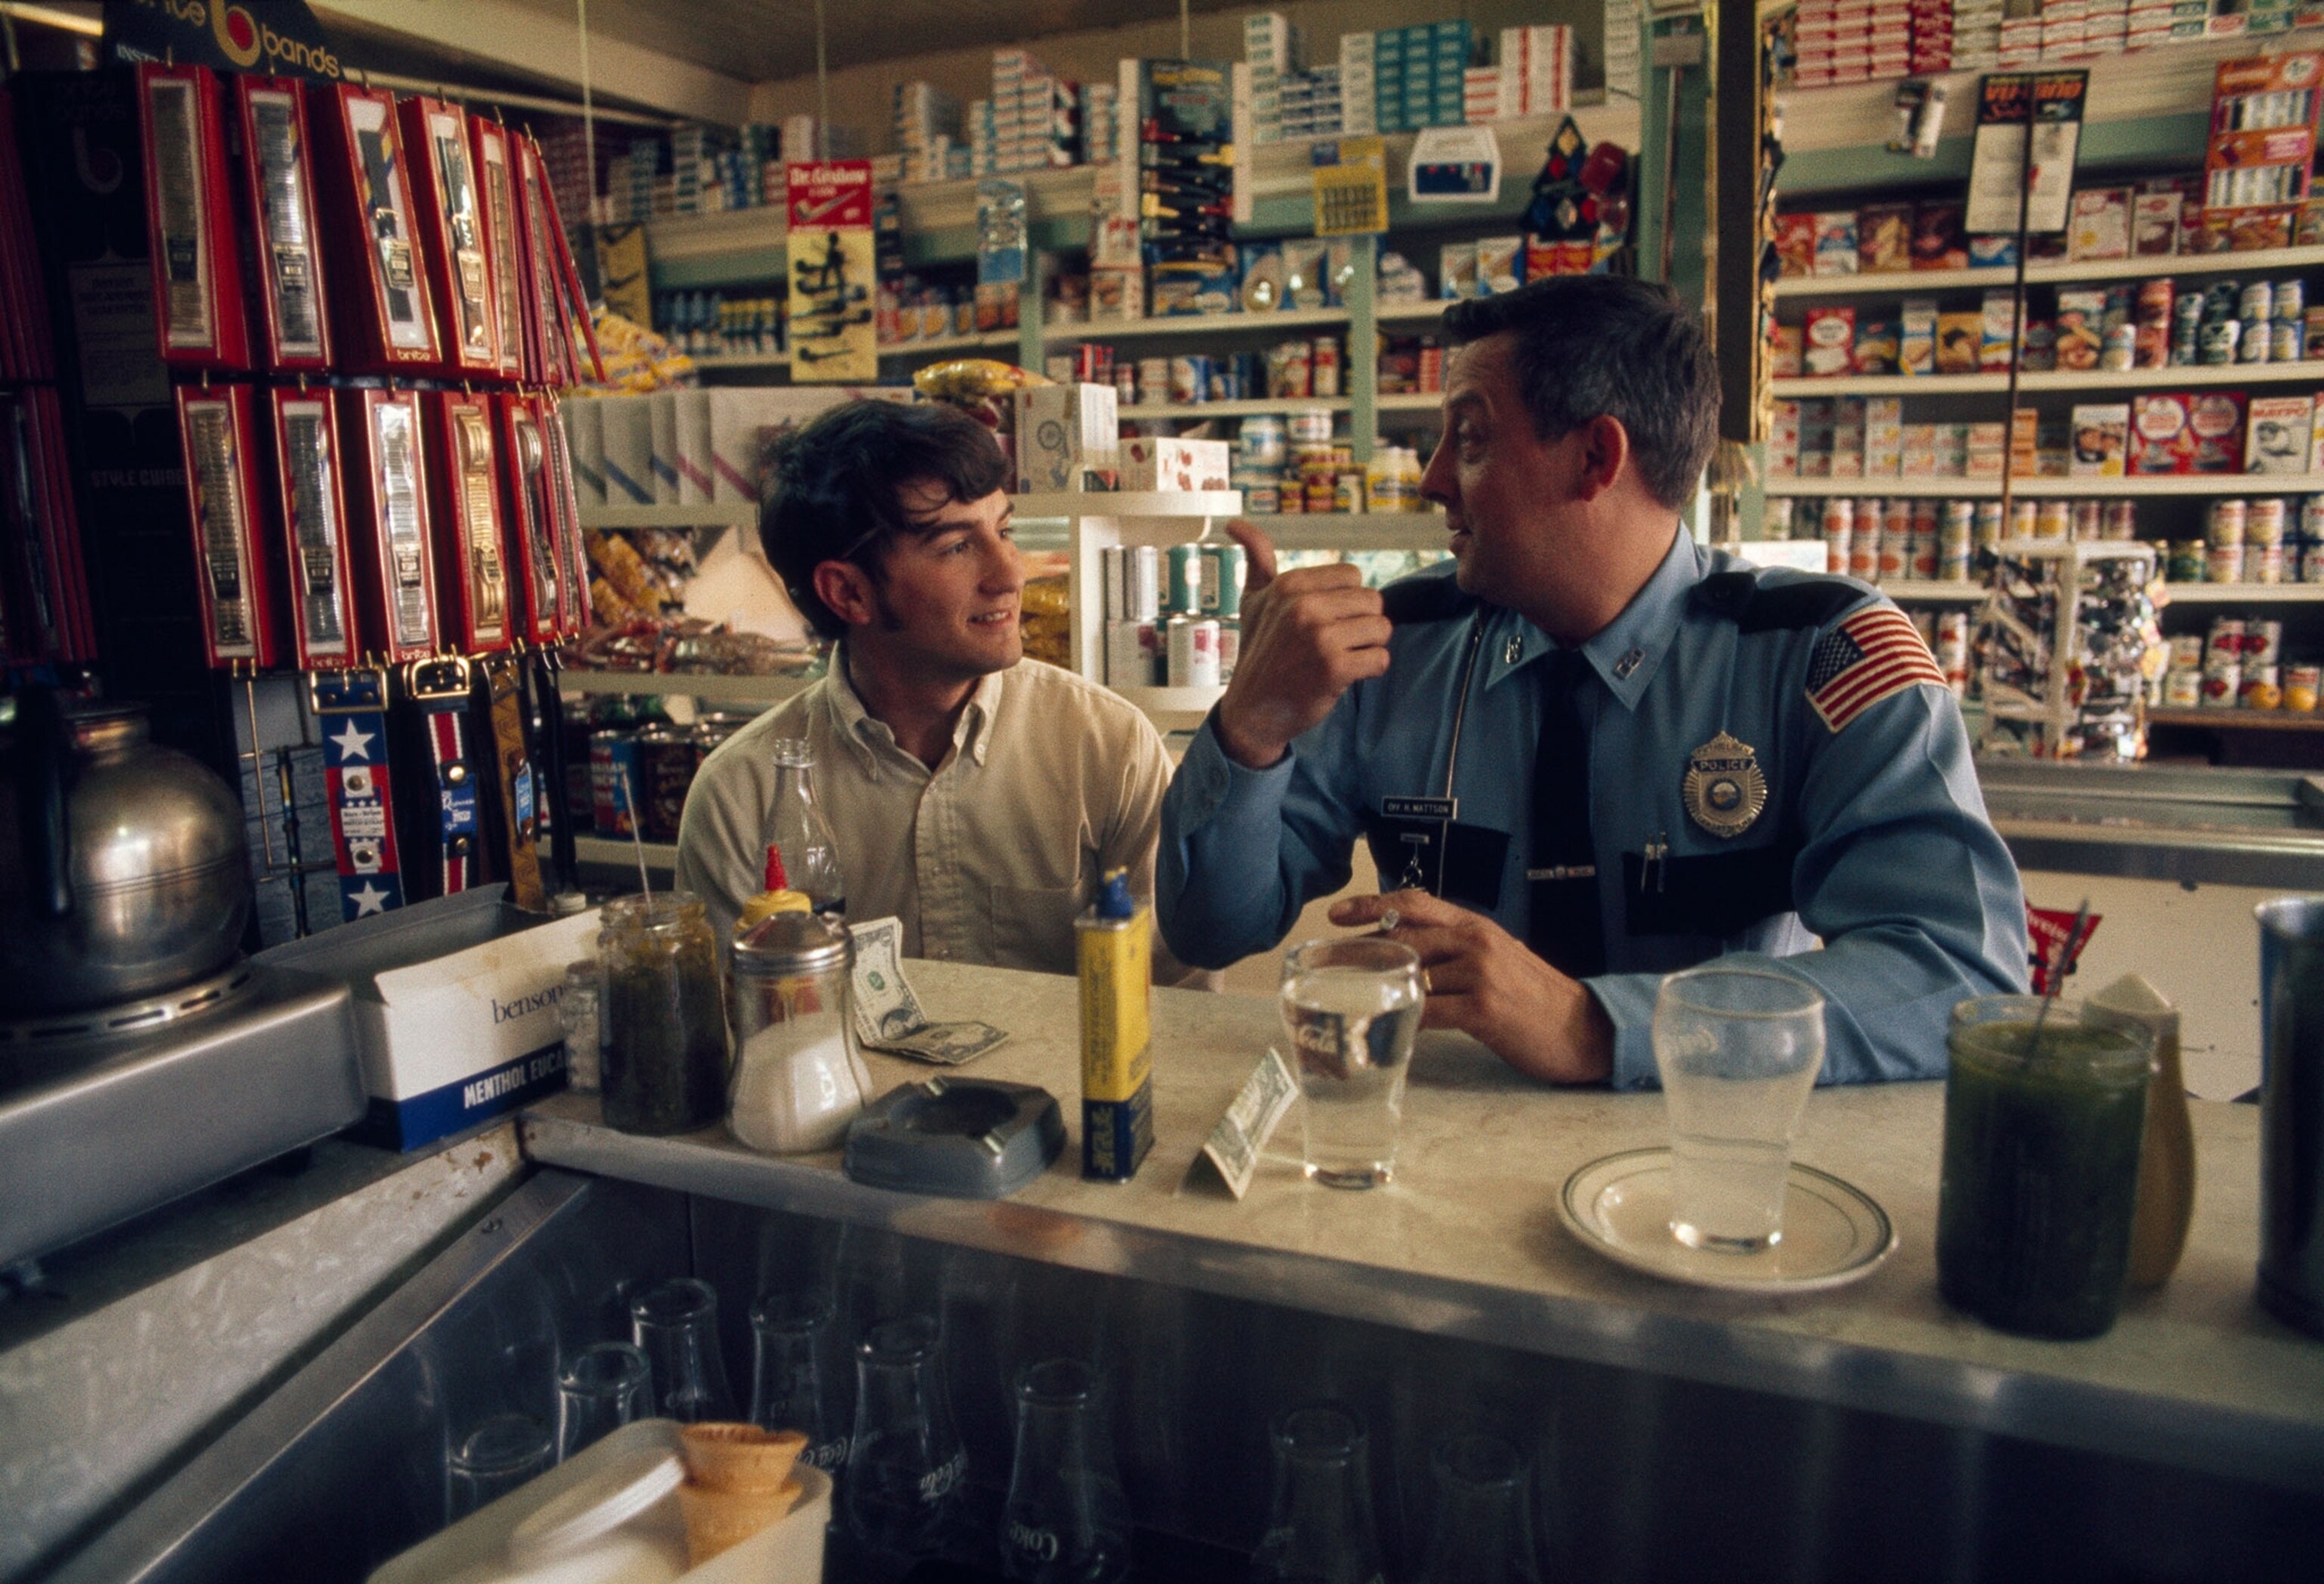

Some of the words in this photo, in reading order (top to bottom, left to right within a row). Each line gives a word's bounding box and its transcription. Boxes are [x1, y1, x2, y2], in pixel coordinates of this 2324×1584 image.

[262, 22, 340, 77] bands
[396, 349, 430, 361] brite
[401, 648, 431, 661] brite
[1700, 760, 1747, 770] POLICE
[492, 984, 566, 1023] benson
[464, 1065, 527, 1109] MENTHOL
